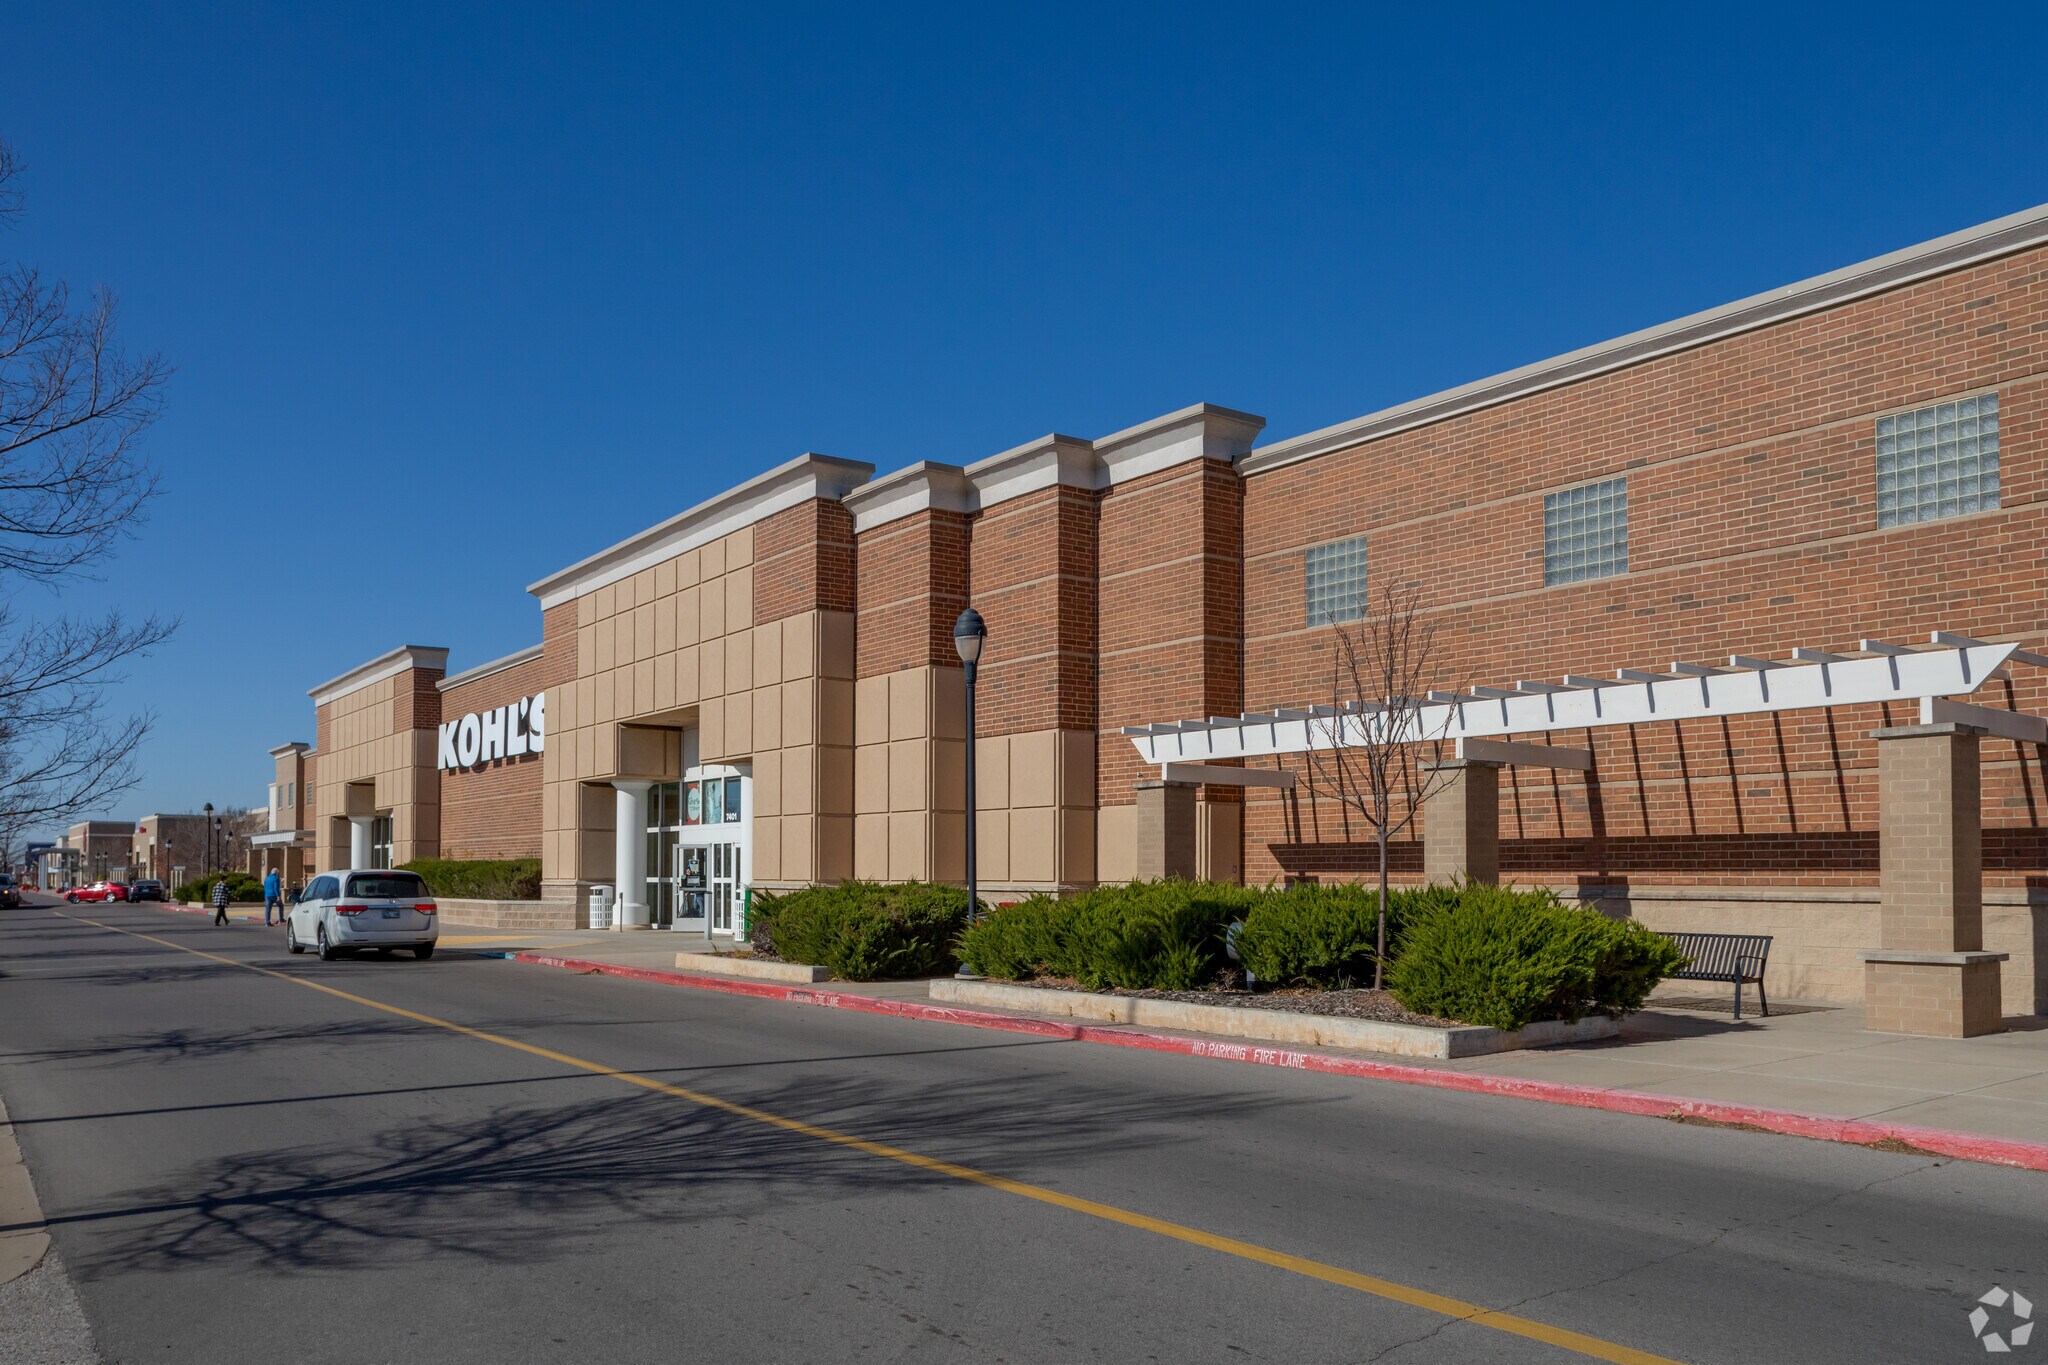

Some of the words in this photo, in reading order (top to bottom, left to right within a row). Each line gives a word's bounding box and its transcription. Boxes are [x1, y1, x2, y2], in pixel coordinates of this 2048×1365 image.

[438, 691, 545, 770] KOHL'S
[826, 995, 840, 1007] LANE
[1192, 1041, 1206, 1056] NO
[1208, 1043, 1246, 1061] PARKING
[1254, 1049, 1277, 1065] FIRE
[1280, 1051, 1307, 1069] LANE
